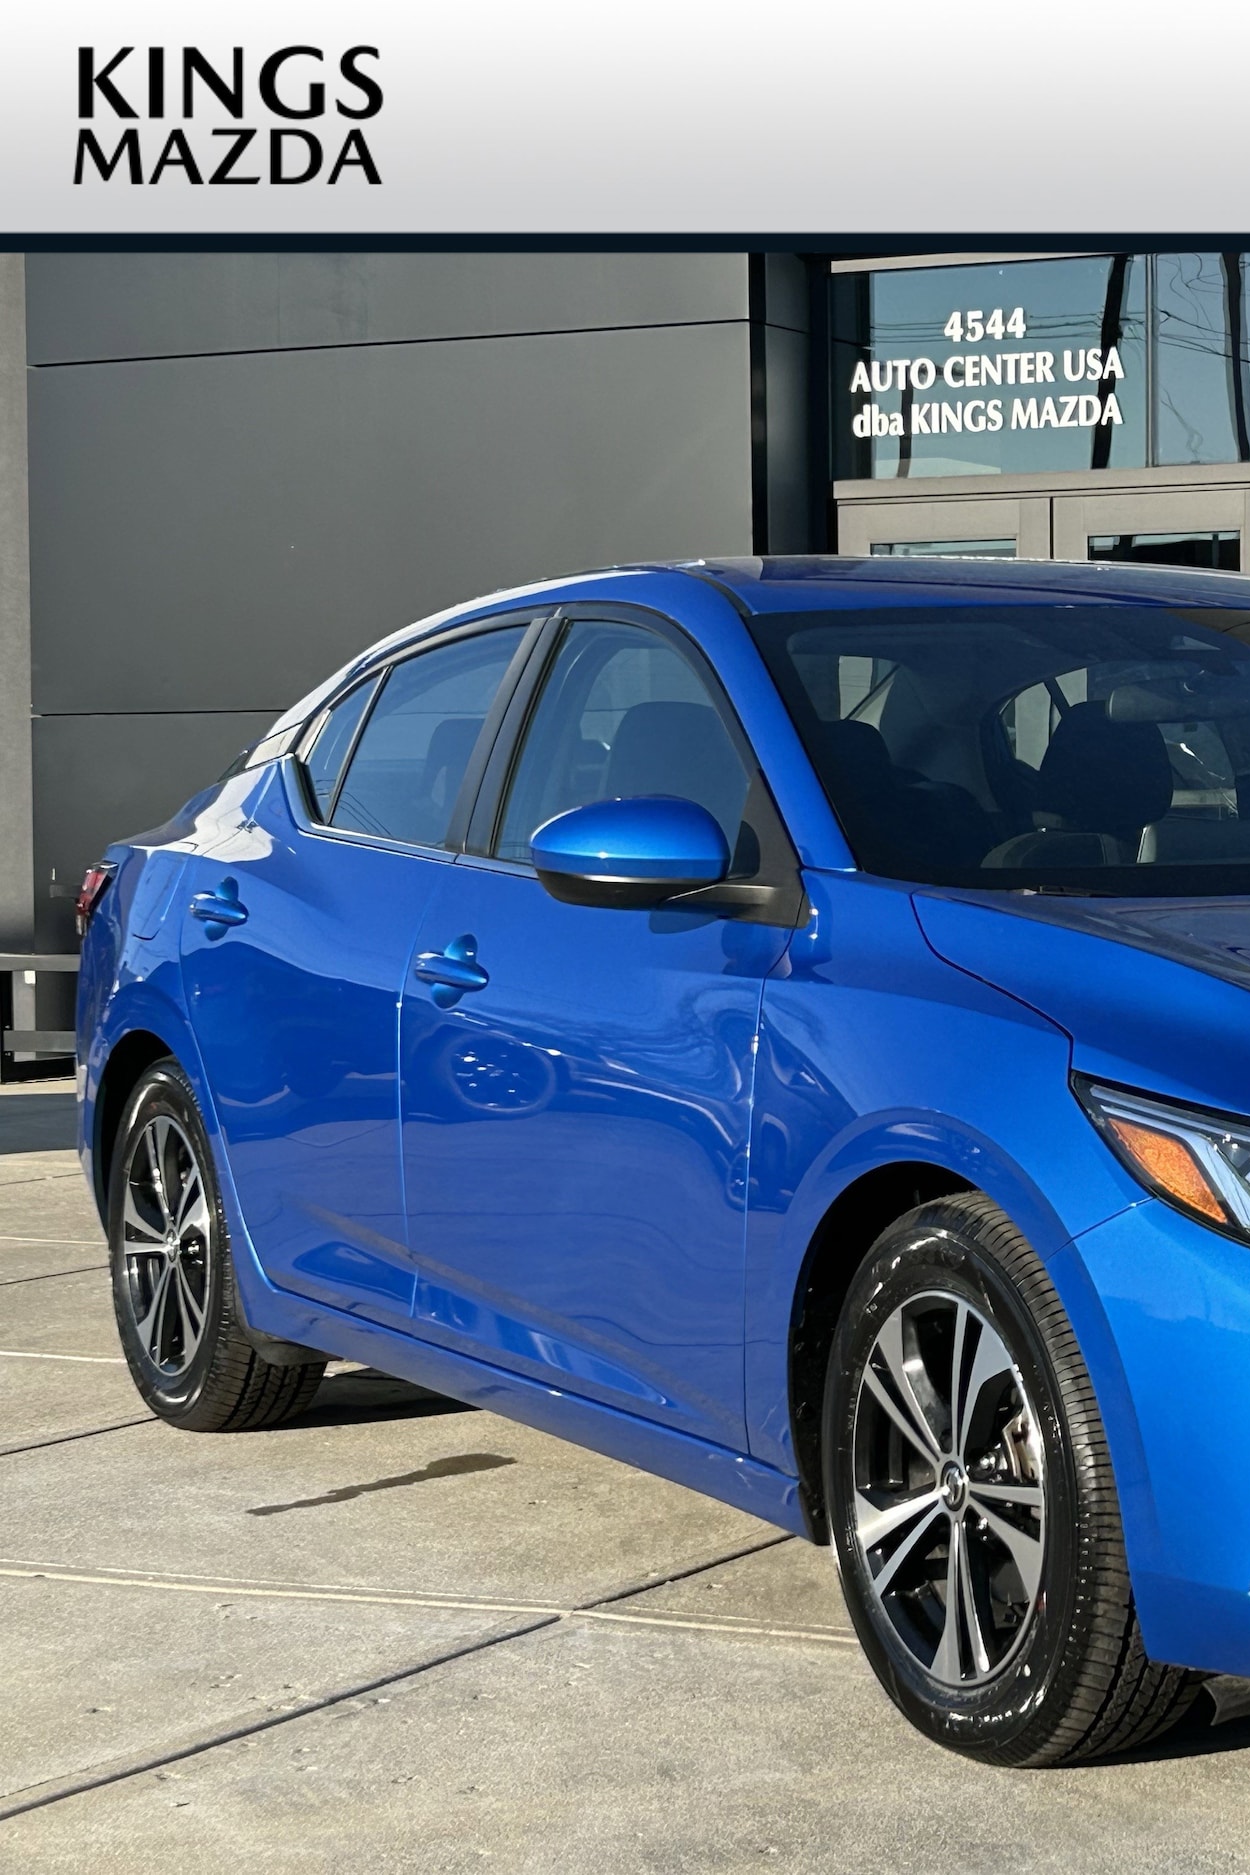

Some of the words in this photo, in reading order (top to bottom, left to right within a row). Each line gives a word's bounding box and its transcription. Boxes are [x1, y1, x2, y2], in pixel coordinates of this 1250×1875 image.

[943, 307, 1027, 343] 4544
[850, 357, 936, 393] AUTO
[943, 350, 1056, 388] CENTER
[1063, 346, 1125, 383] USA
[852, 403, 905, 438] dba
[910, 400, 1004, 435] KINGS
[1010, 392, 1124, 431] MAZDA
